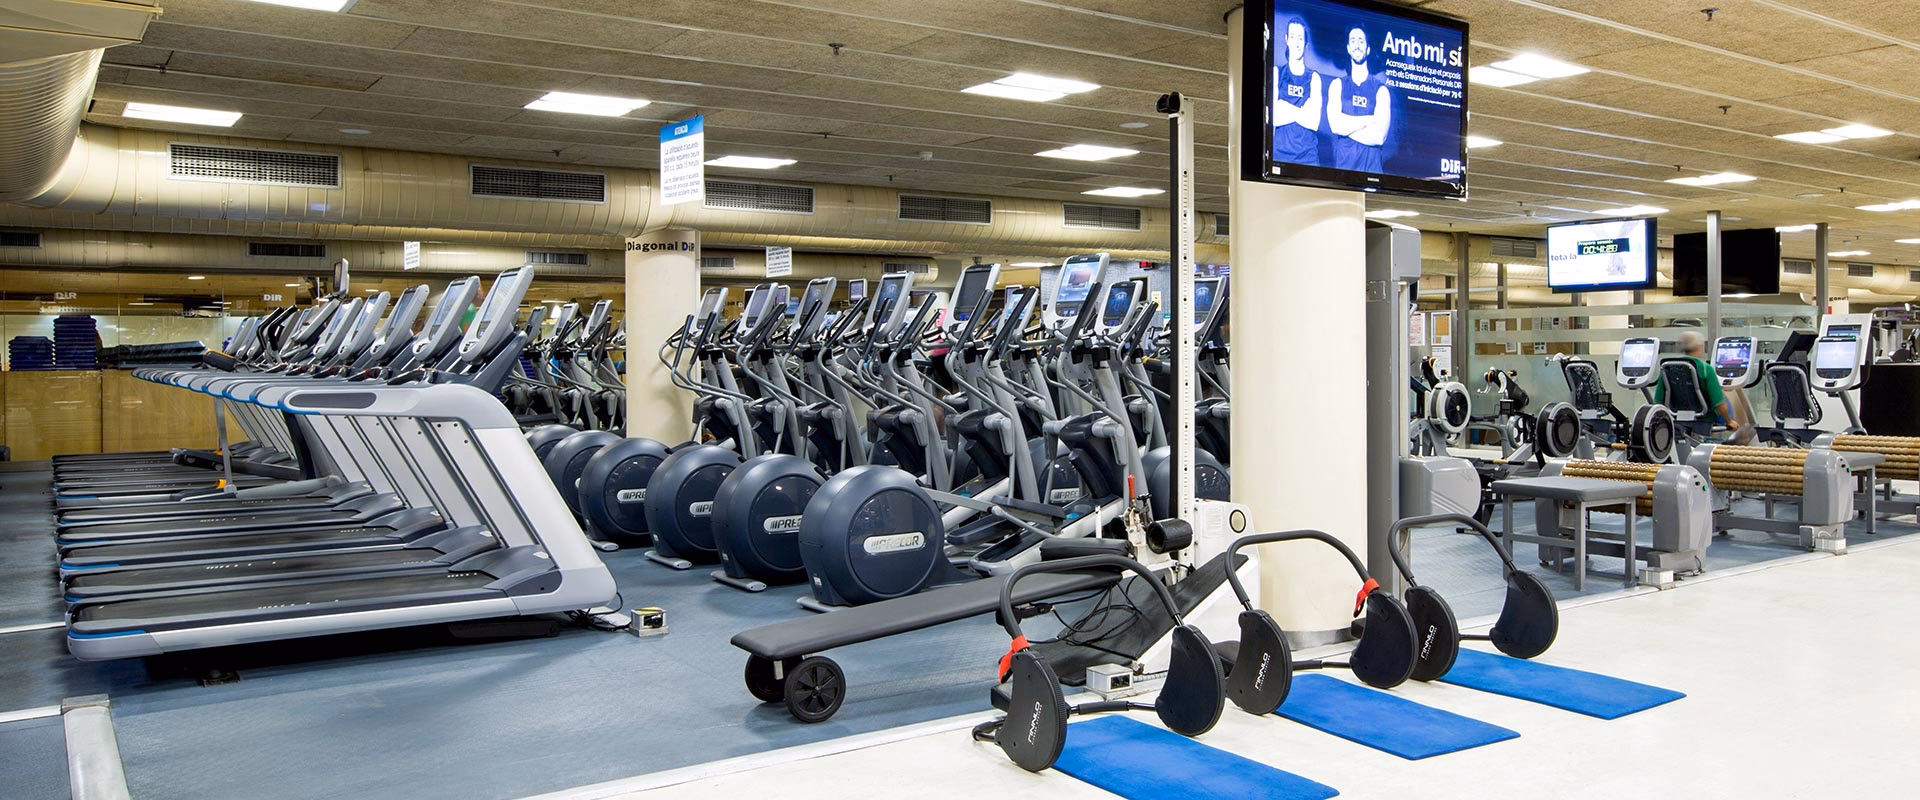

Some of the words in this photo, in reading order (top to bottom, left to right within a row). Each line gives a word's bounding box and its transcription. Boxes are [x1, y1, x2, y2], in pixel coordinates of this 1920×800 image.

[1382, 32, 1422, 58] Amb
[1424, 42, 1446, 66] mi,
[1441, 158, 1460, 173] DiR
[628, 241, 678, 252] Diagonal
[1028, 702, 1040, 742] FINNLO
